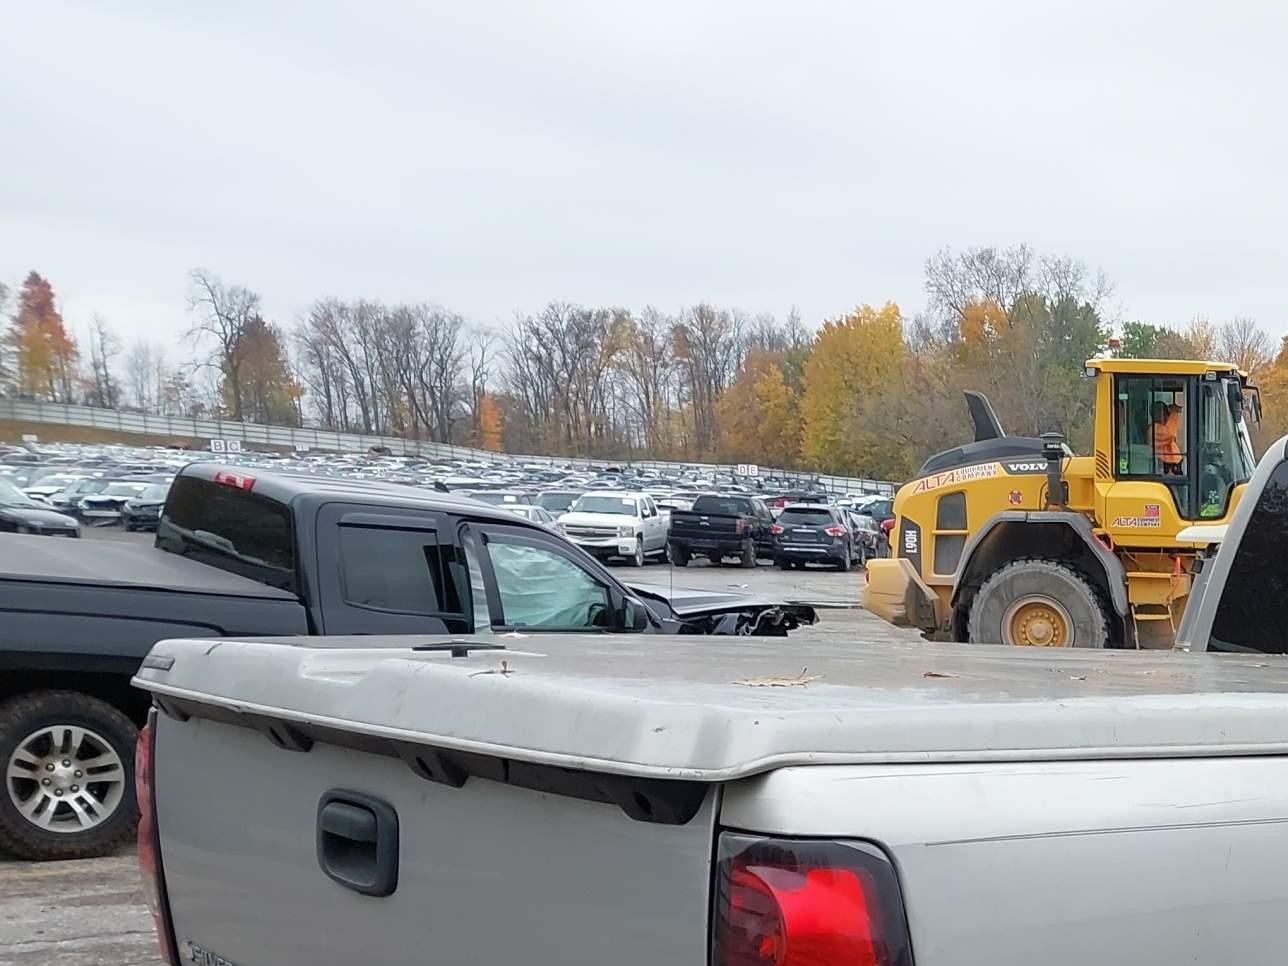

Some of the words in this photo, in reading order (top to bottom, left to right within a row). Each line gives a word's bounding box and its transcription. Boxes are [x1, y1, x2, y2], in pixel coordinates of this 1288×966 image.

[1008, 463, 1048, 471] VOLV
[913, 471, 955, 494] ALTA
[1112, 517, 1137, 526] ALTA
[905, 530, 917, 553] L90H
